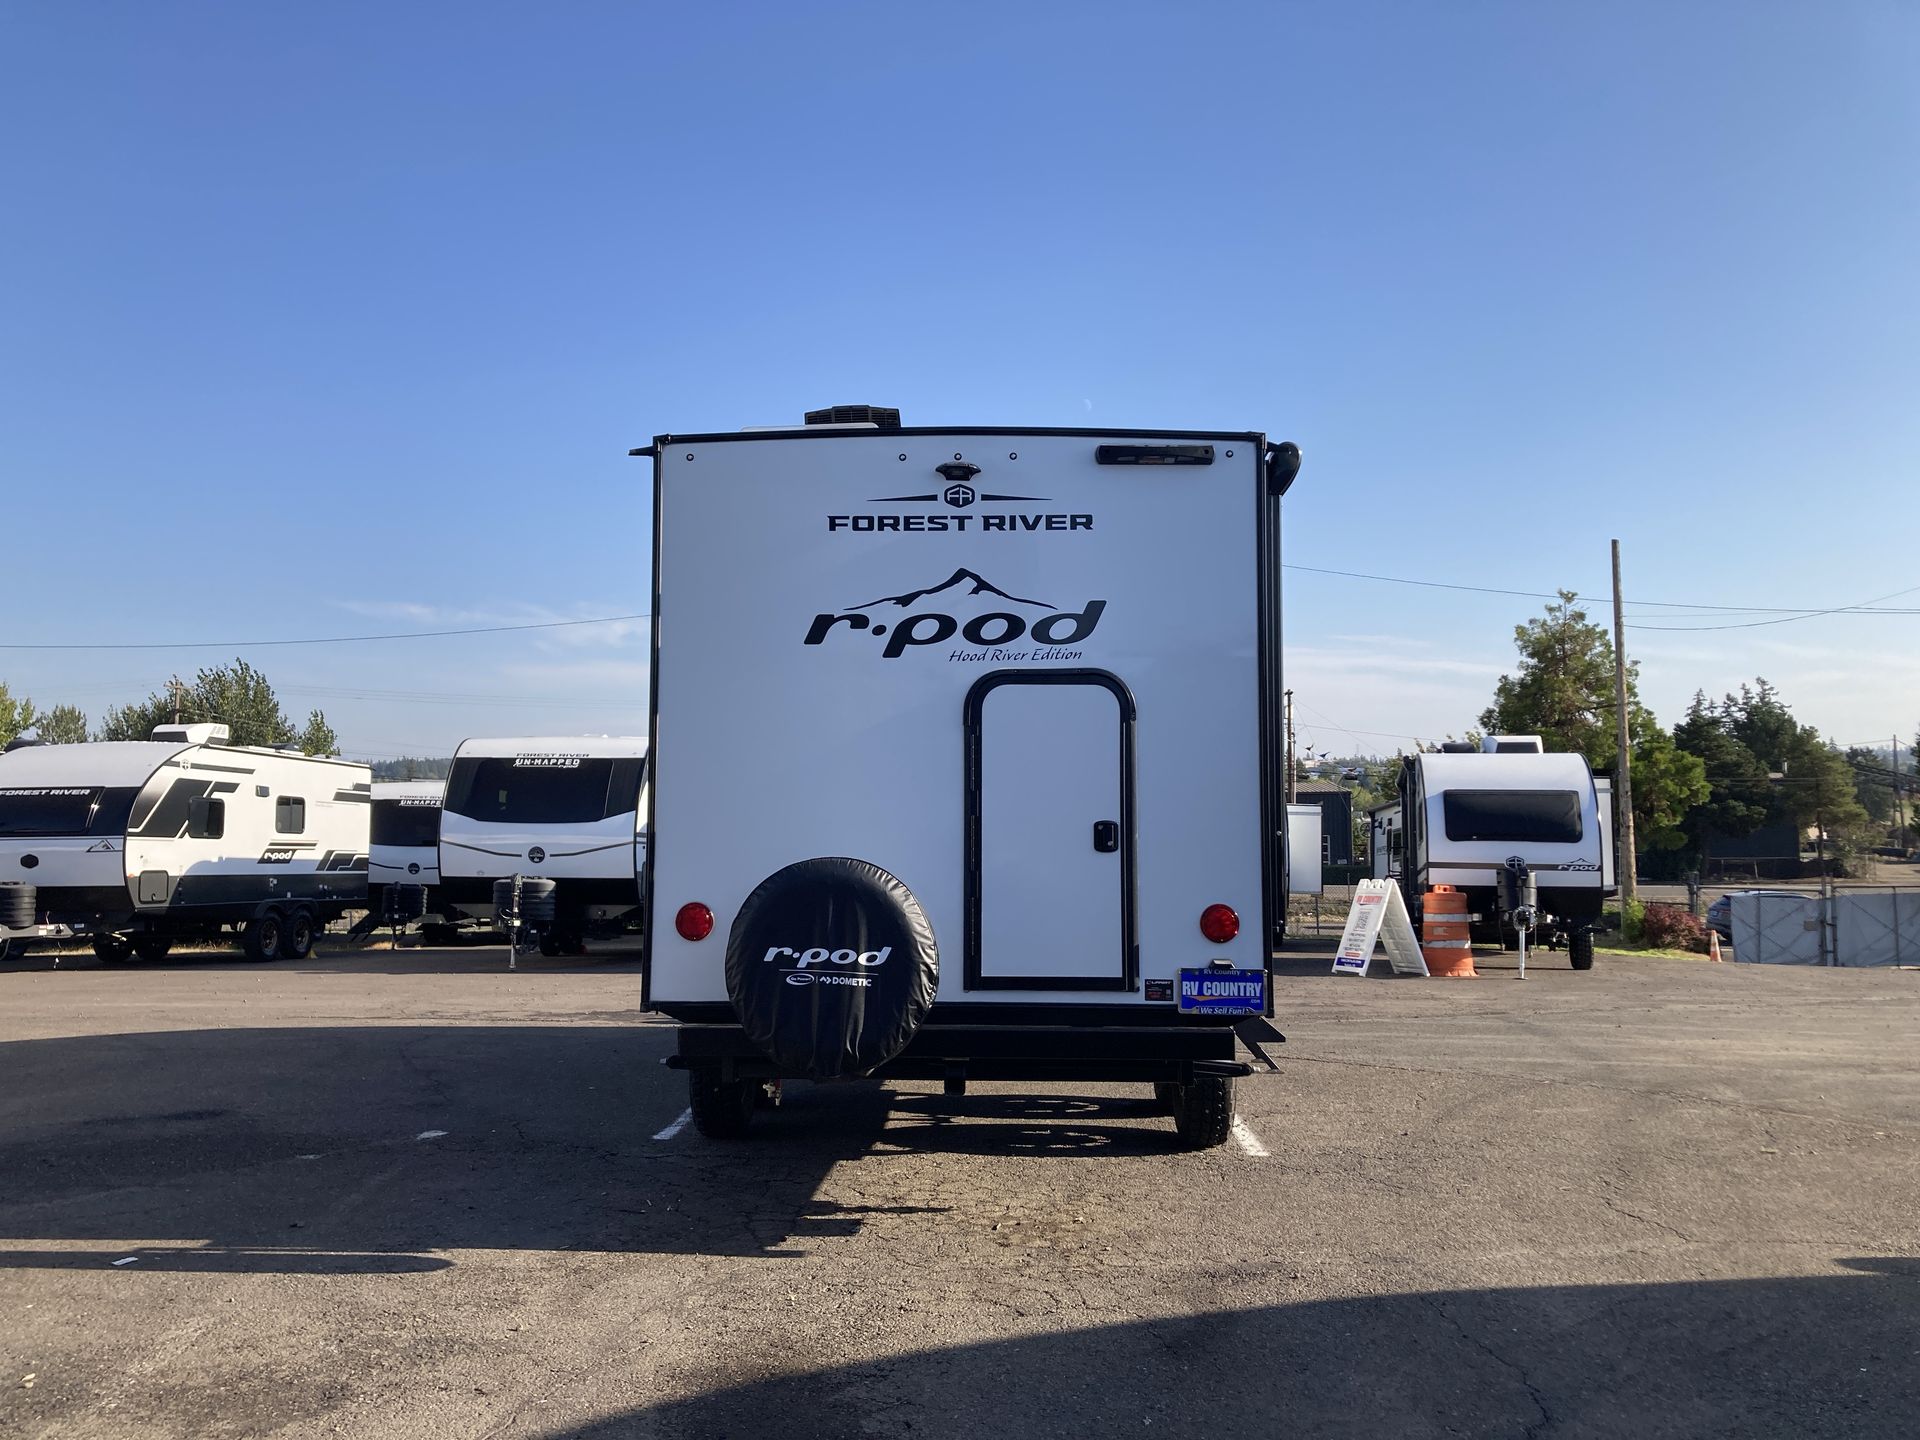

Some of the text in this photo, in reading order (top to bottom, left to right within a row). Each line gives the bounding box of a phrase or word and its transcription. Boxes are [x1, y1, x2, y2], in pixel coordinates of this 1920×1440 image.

[827, 514, 1094, 532] FOREST RIVER
[949, 646, 1083, 663] Hood River Edition
[1214, 968, 1241, 976] Country
[832, 976, 872, 987] DOMETIC
[1182, 981, 1262, 997] RV COUNTRY
[1200, 1006, 1245, 1015] We Sell Fun!
